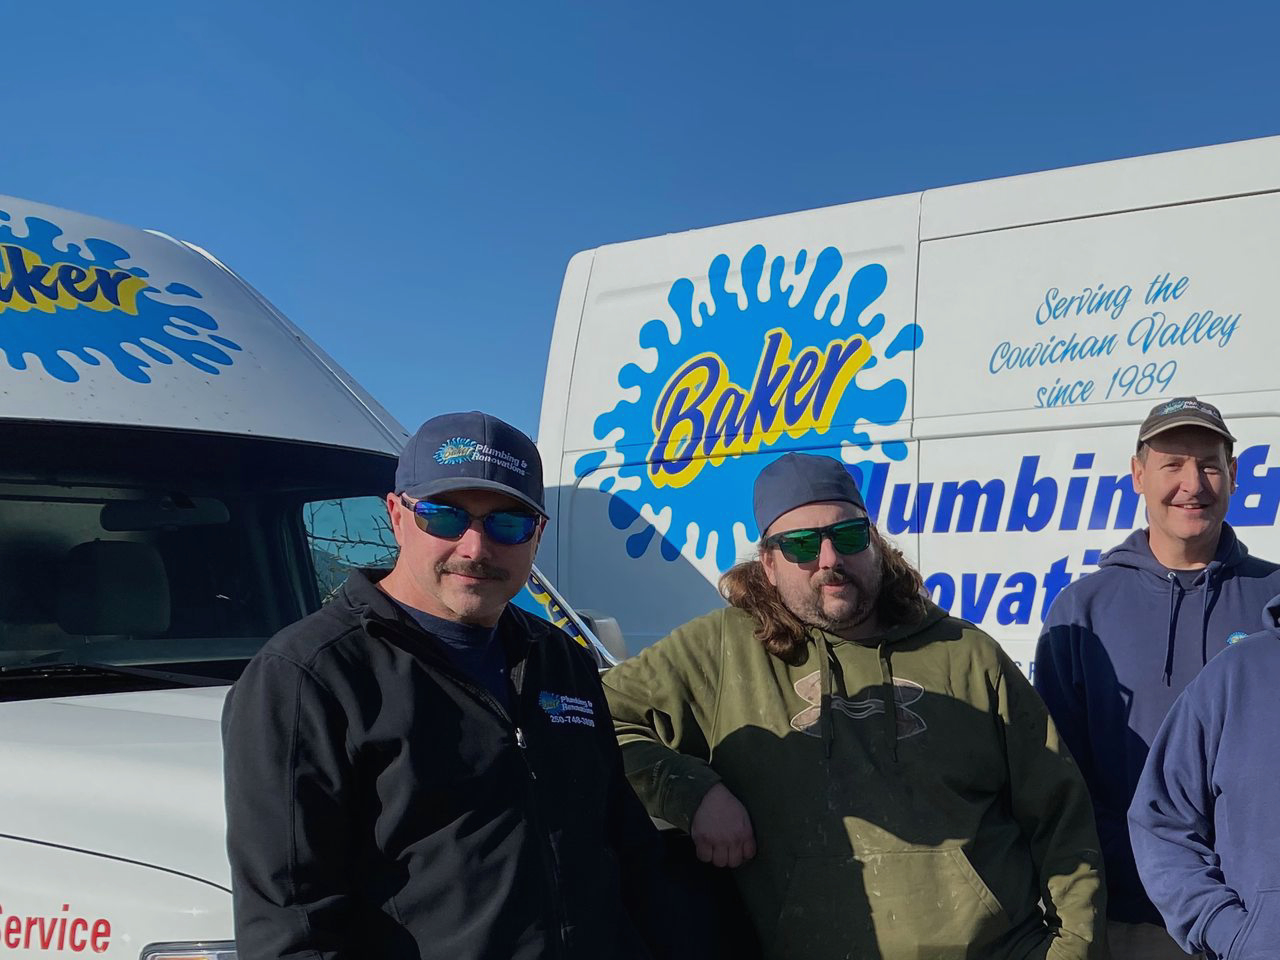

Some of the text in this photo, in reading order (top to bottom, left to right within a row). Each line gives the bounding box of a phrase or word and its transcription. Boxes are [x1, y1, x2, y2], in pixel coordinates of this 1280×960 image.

[1035, 272, 1190, 325] Serving the
[988, 310, 1242, 374] Cowichan Valley
[648, 331, 868, 480] Baker
[1033, 360, 1178, 409] since 1989
[471, 451, 525, 476] Renovations
[475, 443, 528, 469] Plumbing &
[844, 453, 1150, 535] lumbin
[0, 903, 111, 954] ervice
